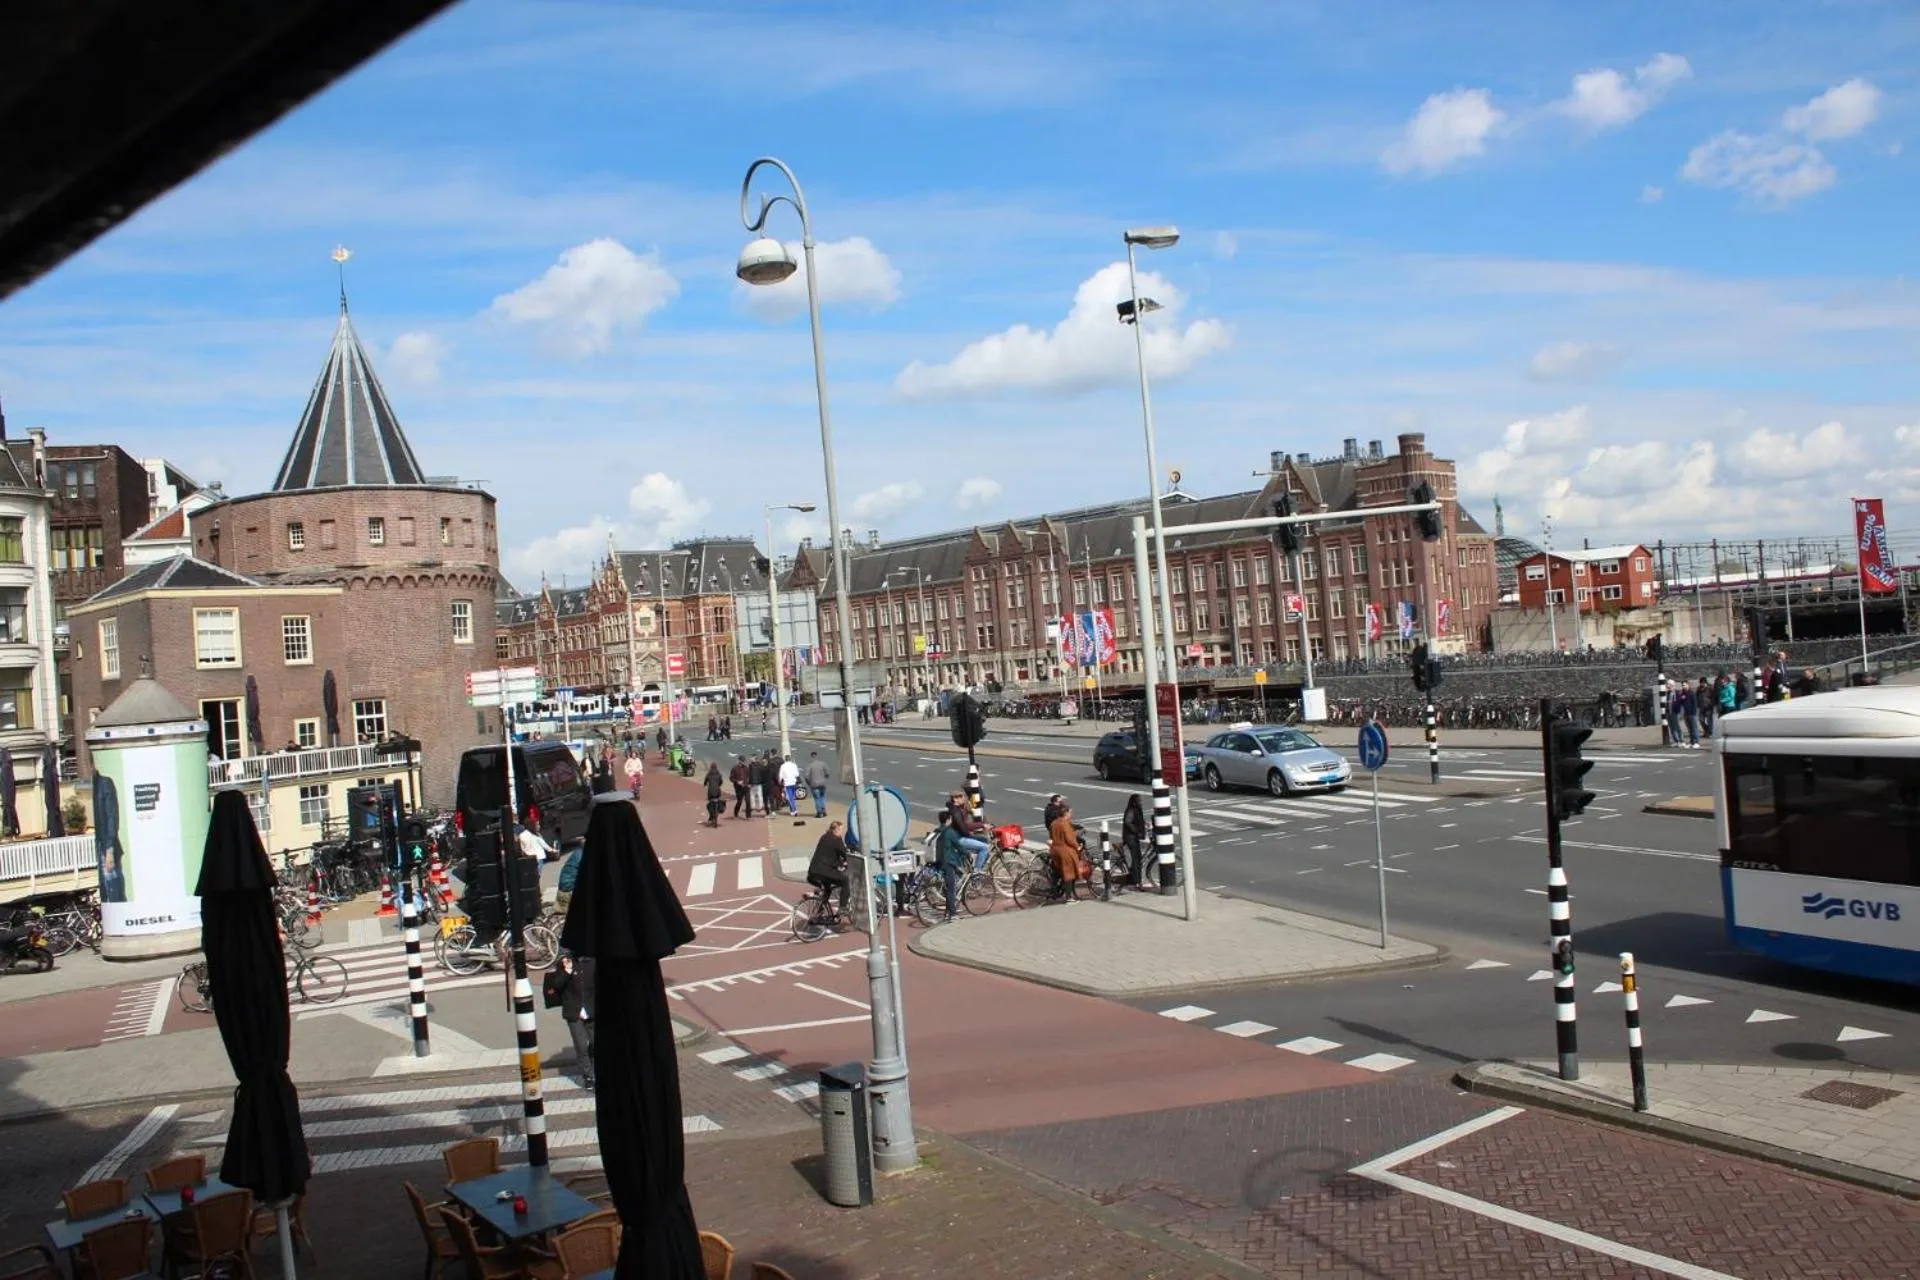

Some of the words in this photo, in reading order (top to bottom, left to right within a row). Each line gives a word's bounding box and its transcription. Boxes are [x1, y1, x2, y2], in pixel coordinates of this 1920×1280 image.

[1865, 563, 1894, 587] DAM
[125, 914, 176, 927] DIESEL
[1849, 899, 1901, 922] GVB
